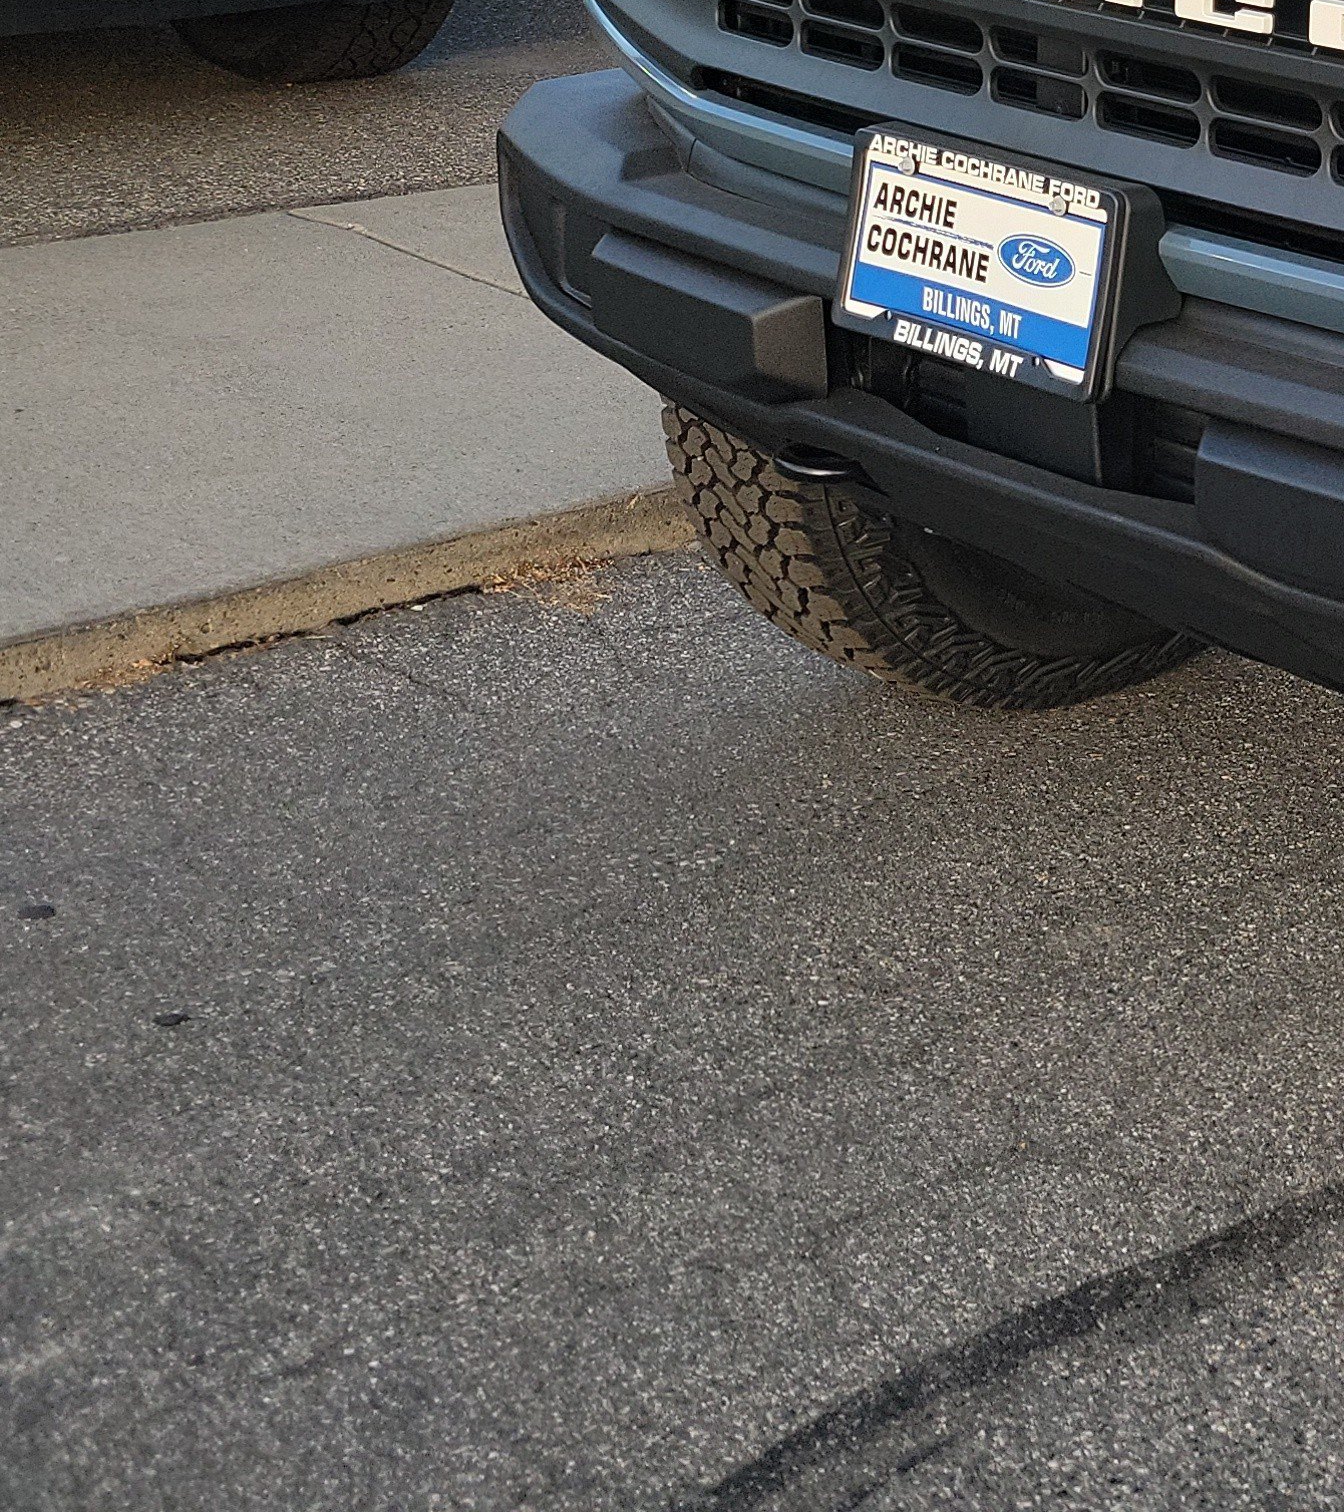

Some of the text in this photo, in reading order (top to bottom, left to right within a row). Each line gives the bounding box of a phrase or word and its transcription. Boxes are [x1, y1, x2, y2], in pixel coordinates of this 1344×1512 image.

[869, 134, 1100, 208] ARCHIE COCHRANE FORD
[873, 182, 957, 229] ARCHIE
[867, 224, 990, 284] COCHRANE
[1012, 243, 1058, 280] Ford
[922, 287, 1022, 339] BILLINGS, MT
[893, 319, 1024, 378] BILLINGS, MT
